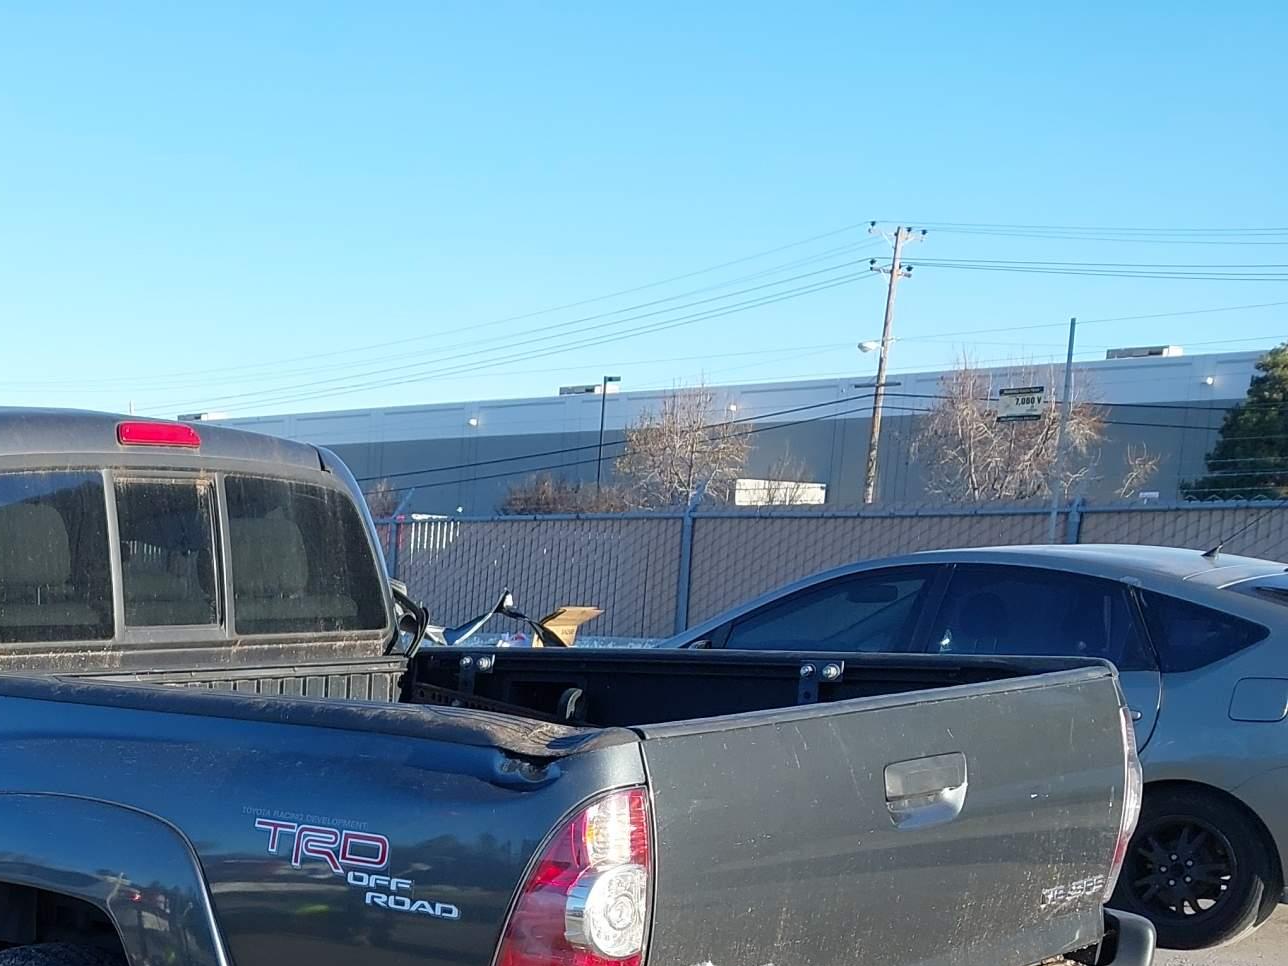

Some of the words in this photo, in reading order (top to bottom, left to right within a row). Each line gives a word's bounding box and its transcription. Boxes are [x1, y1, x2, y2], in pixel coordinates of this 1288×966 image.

[241, 806, 272, 817] TOYOTA
[306, 813, 368, 829] DEVELOPMENT
[255, 818, 390, 873] TRD
[347, 871, 413, 891] OFF
[365, 892, 461, 920] ROAD
